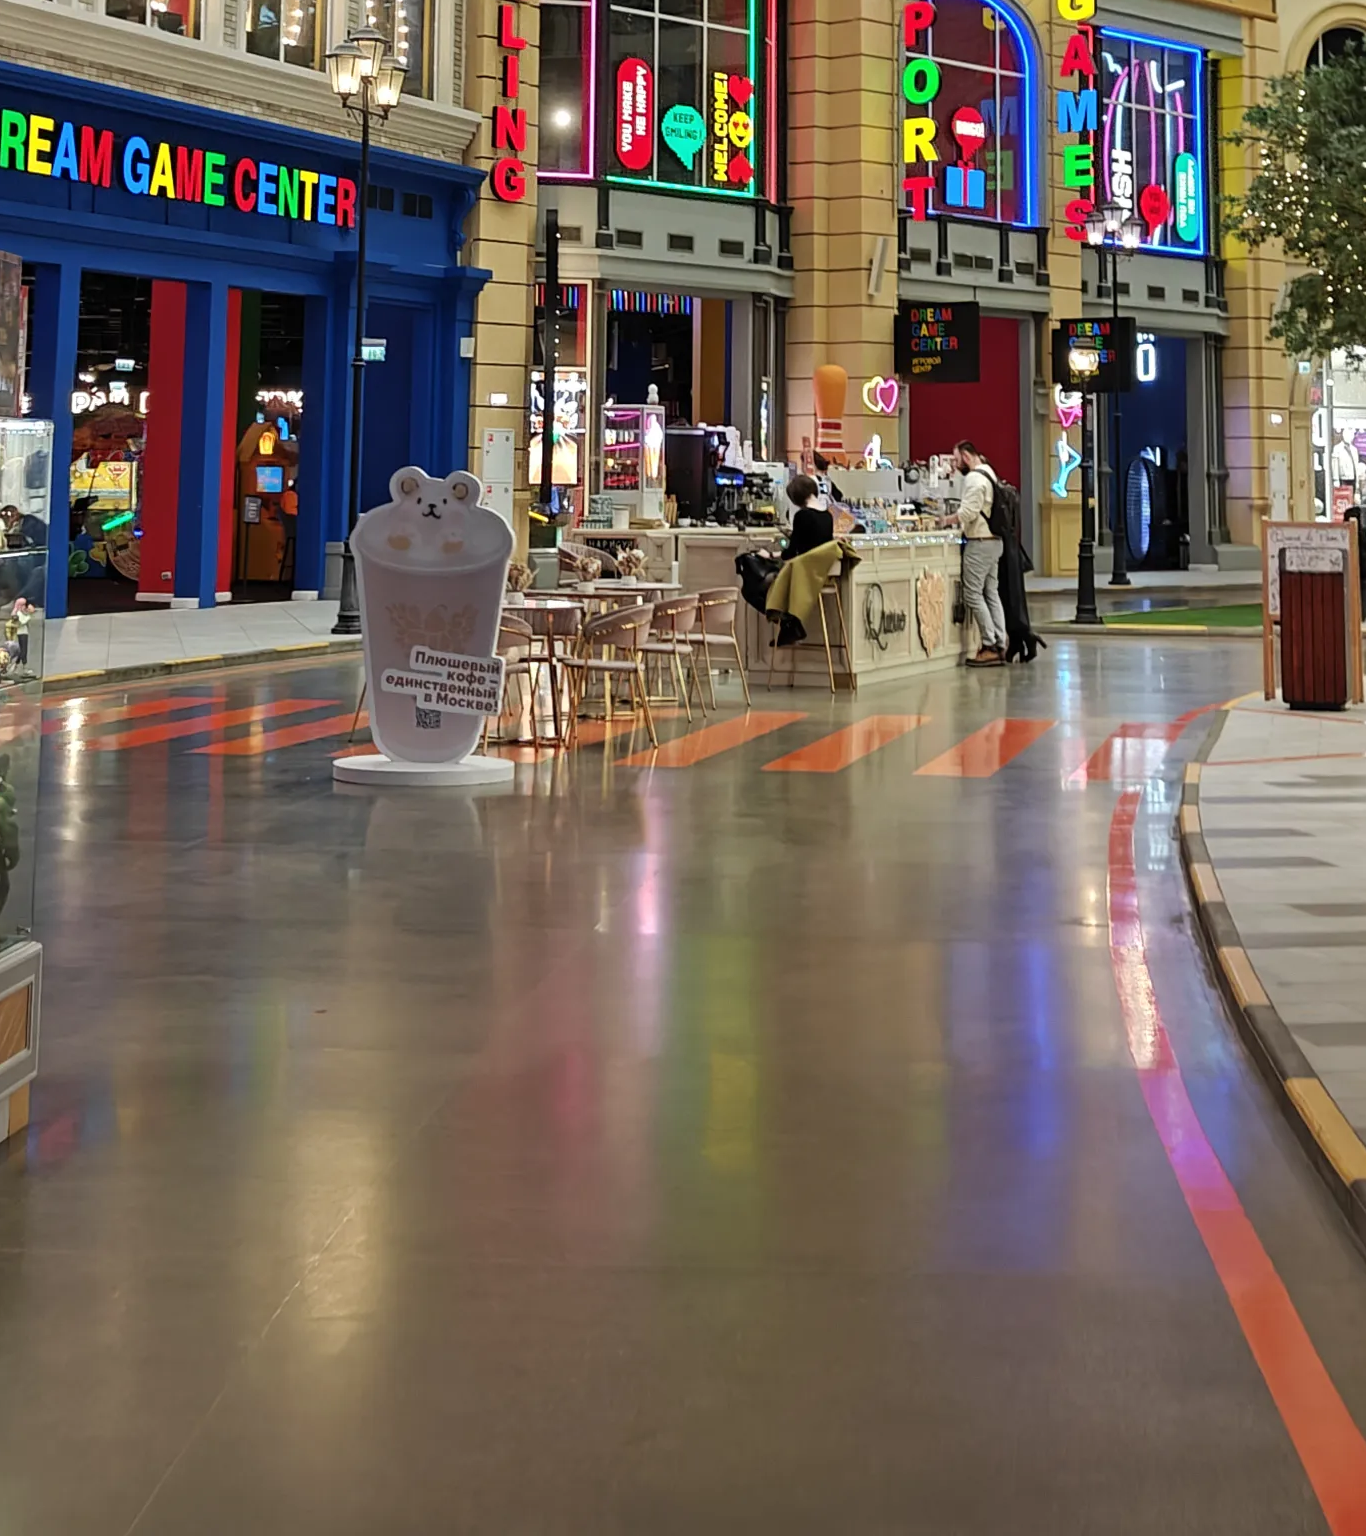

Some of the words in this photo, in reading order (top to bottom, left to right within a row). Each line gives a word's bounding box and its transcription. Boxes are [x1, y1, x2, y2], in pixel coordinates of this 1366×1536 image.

[636, 65, 648, 113] HAPPY
[673, 113, 694, 124] KEEP
[714, 72, 729, 182] WELCOME!
[621, 123, 633, 152] YOU
[123, 136, 227, 207] GAME
[234, 157, 357, 228] CENTER
[911, 308, 953, 323] DREAM
[911, 323, 945, 337] GAME
[1068, 322, 1111, 337] DREAM
[910, 336, 959, 351] CENTER
[415, 651, 501, 675] Плюшевый
[386, 675, 496, 700] единственный
[446, 671, 486, 686] кофе
[424, 693, 432, 703] в
[436, 692, 498, 713] Москве!
